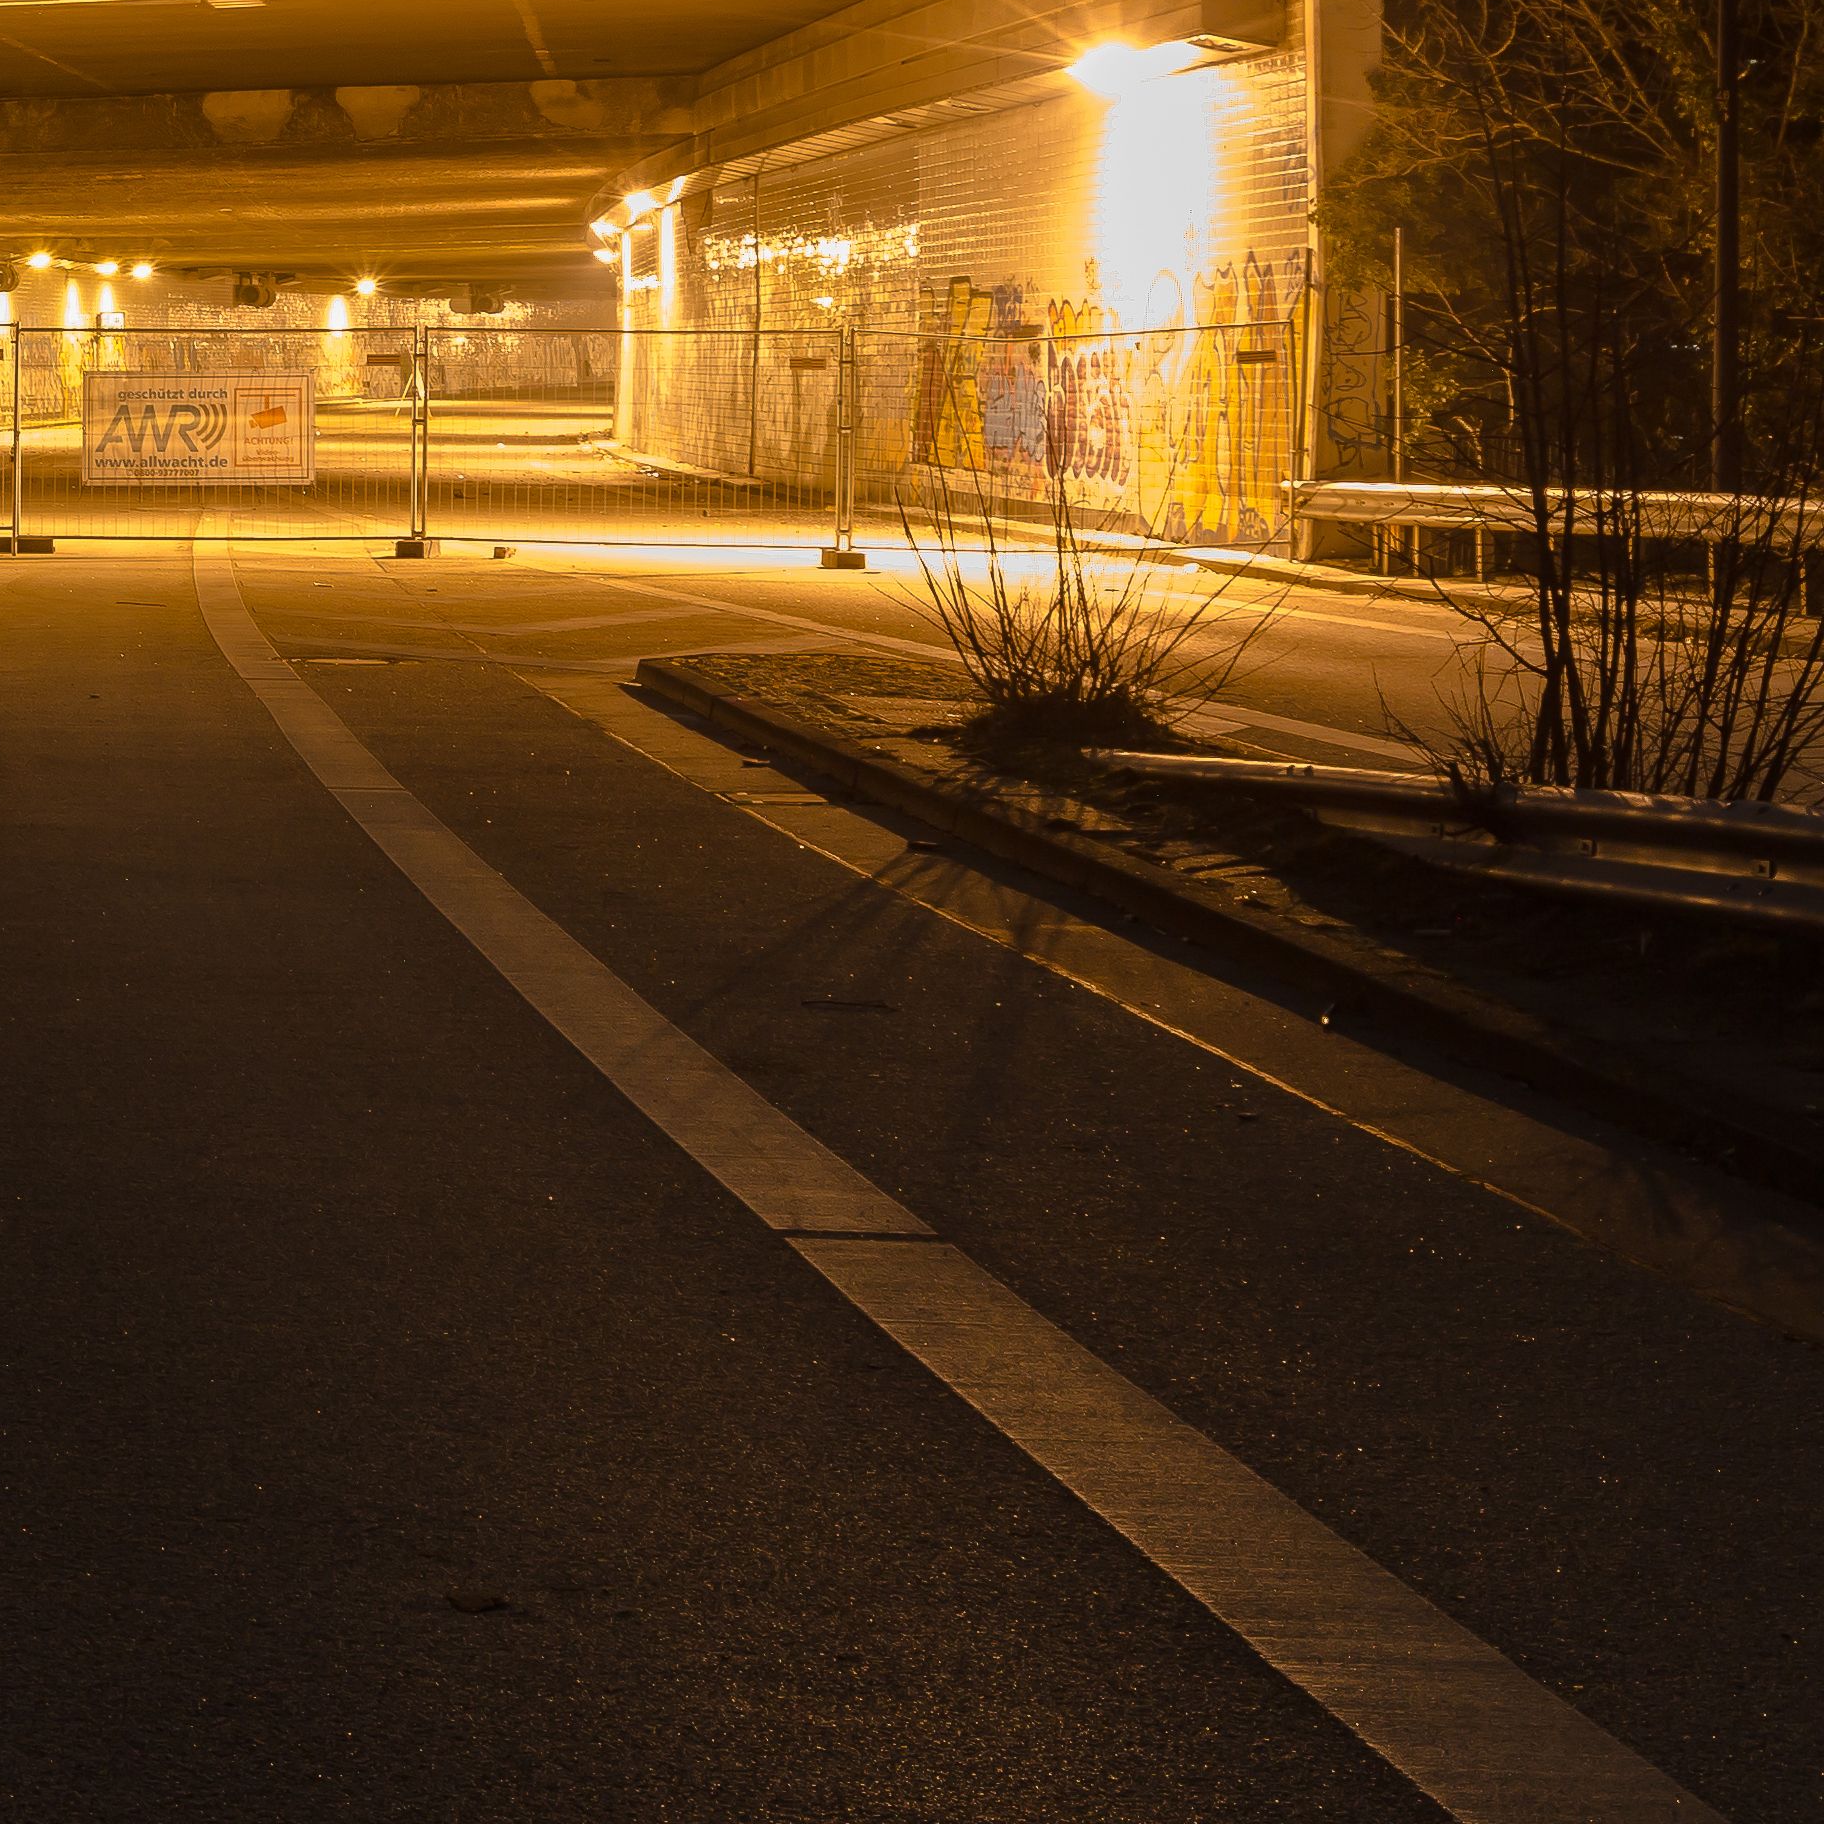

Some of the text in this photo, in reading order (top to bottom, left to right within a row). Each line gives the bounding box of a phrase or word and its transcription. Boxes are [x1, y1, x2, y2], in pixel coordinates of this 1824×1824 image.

[118, 388, 228, 402] geschützt durch
[95, 403, 202, 453] AWR
[243, 436, 294, 446] ACHTUNG!
[95, 456, 229, 469] www.allwacht.de
